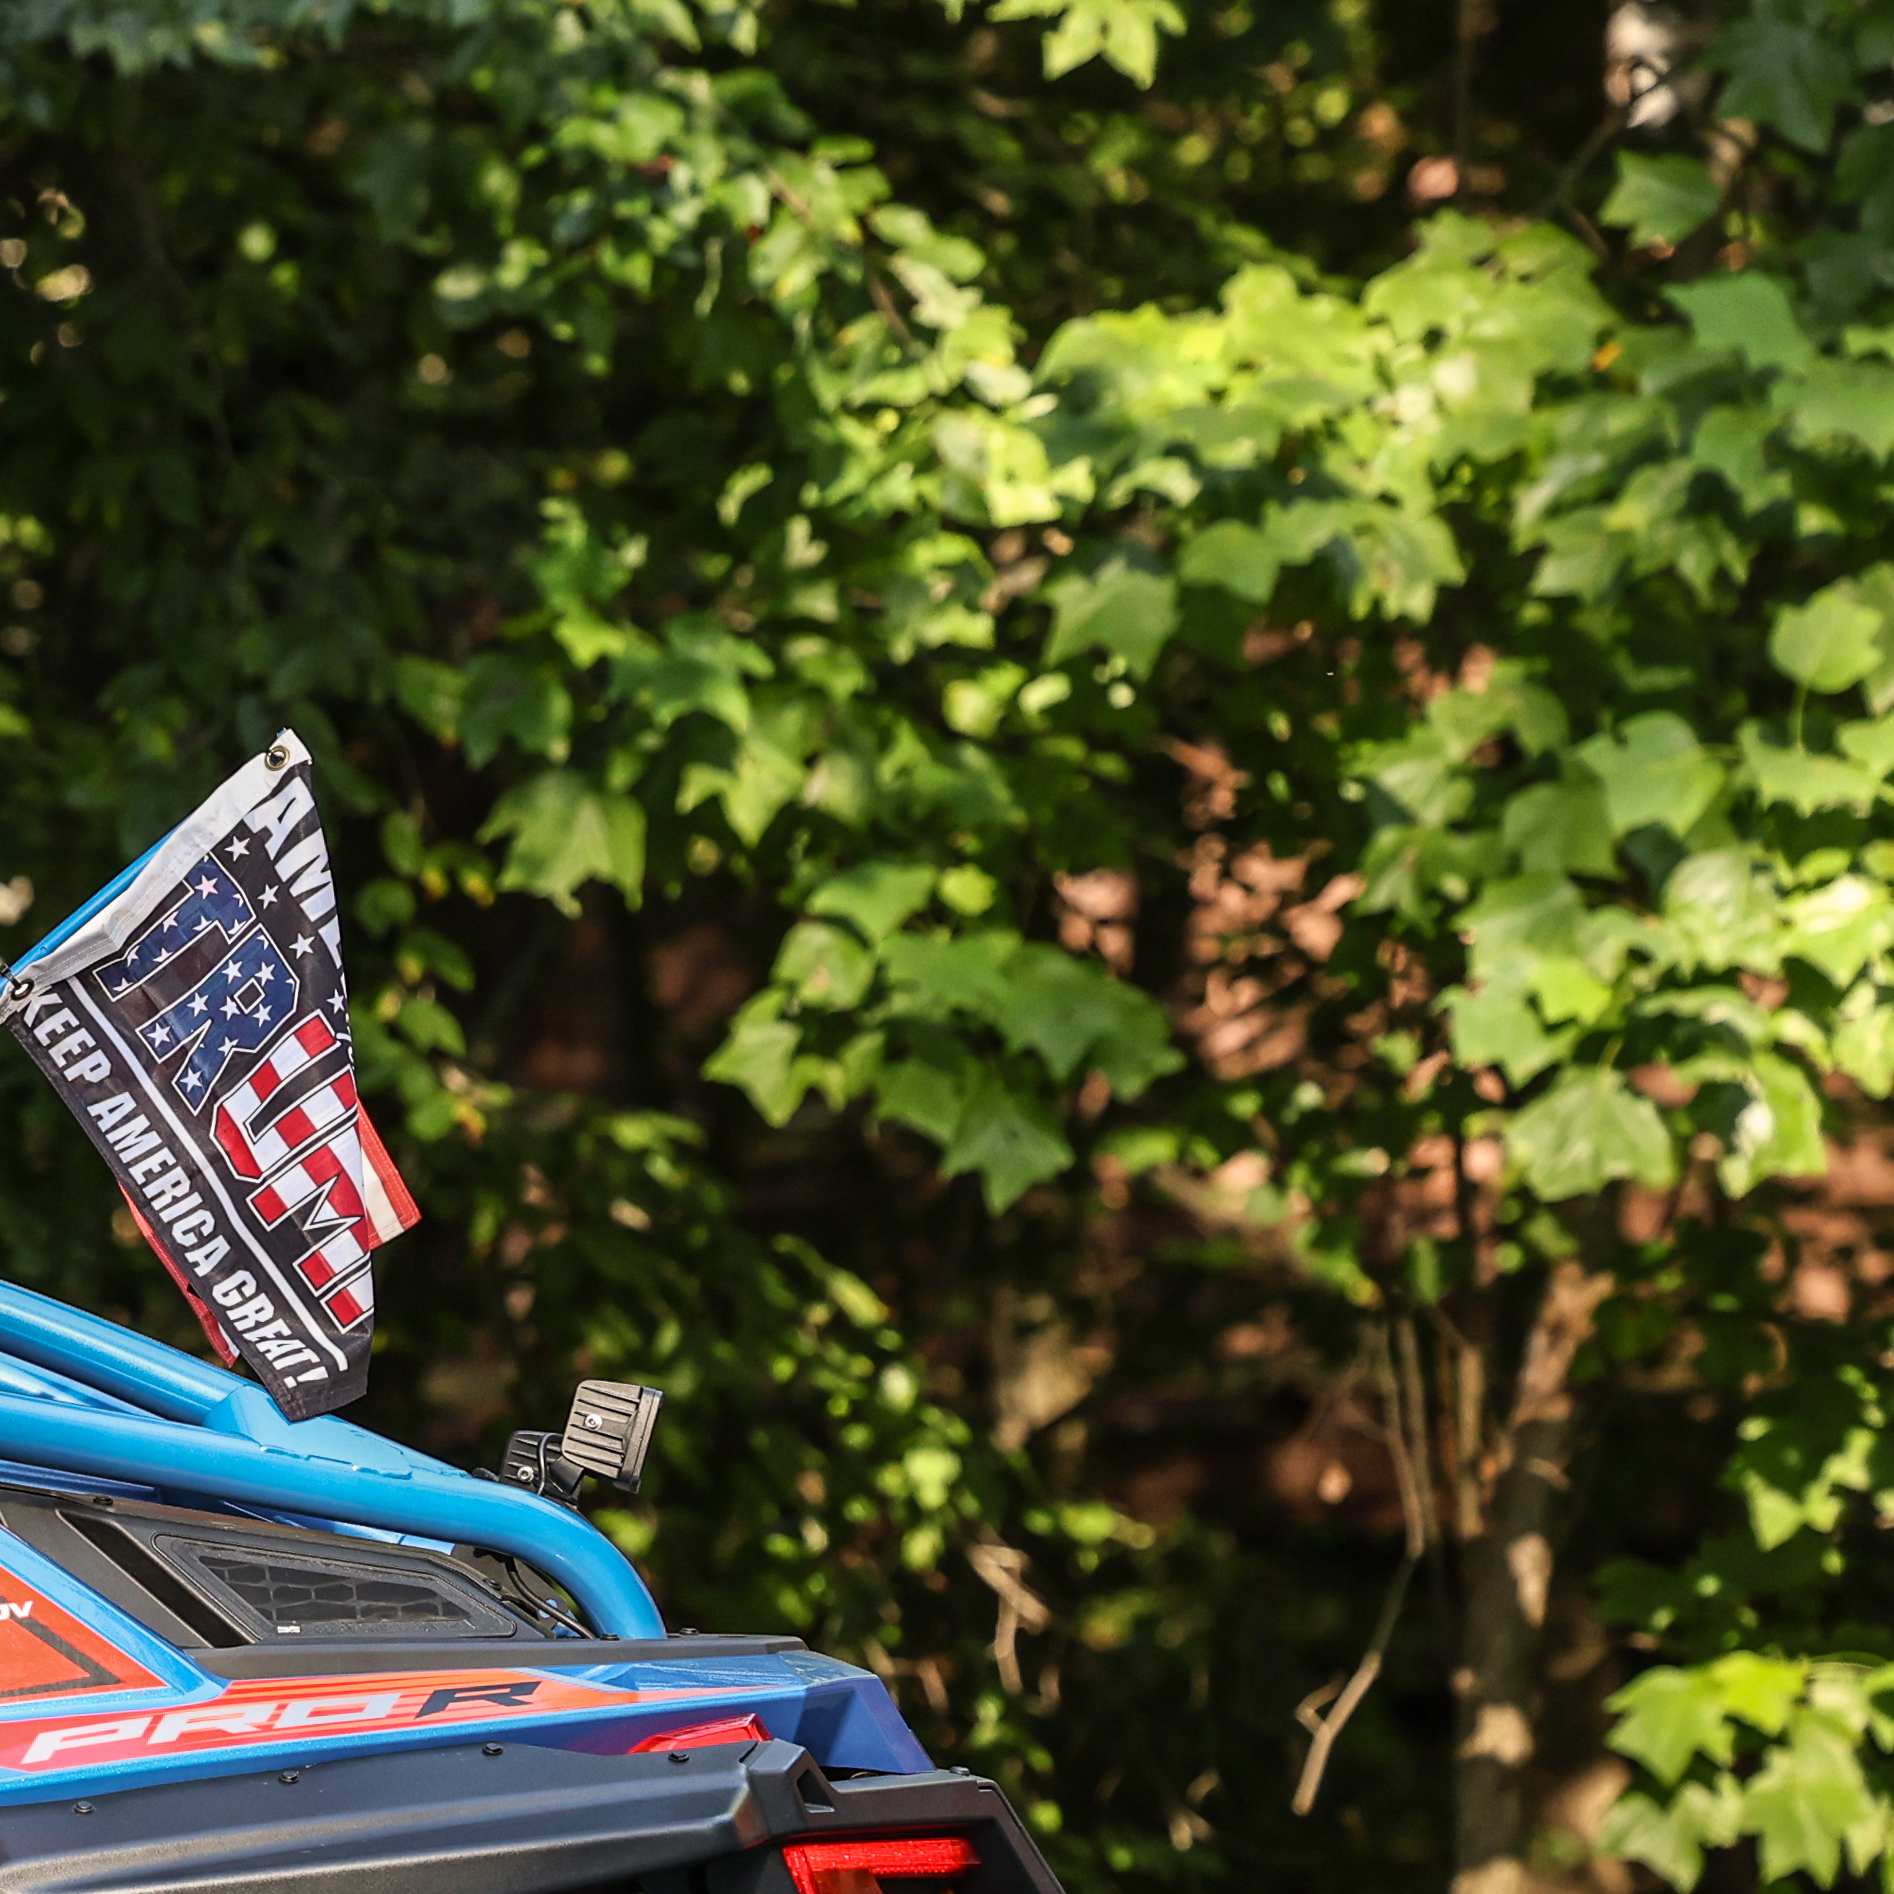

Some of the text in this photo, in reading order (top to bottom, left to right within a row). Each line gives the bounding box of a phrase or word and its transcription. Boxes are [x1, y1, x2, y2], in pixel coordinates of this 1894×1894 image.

[16, 984, 329, 1389] KEEP AMERICA GREAT!
[20, 1681, 540, 1765] PRO R
